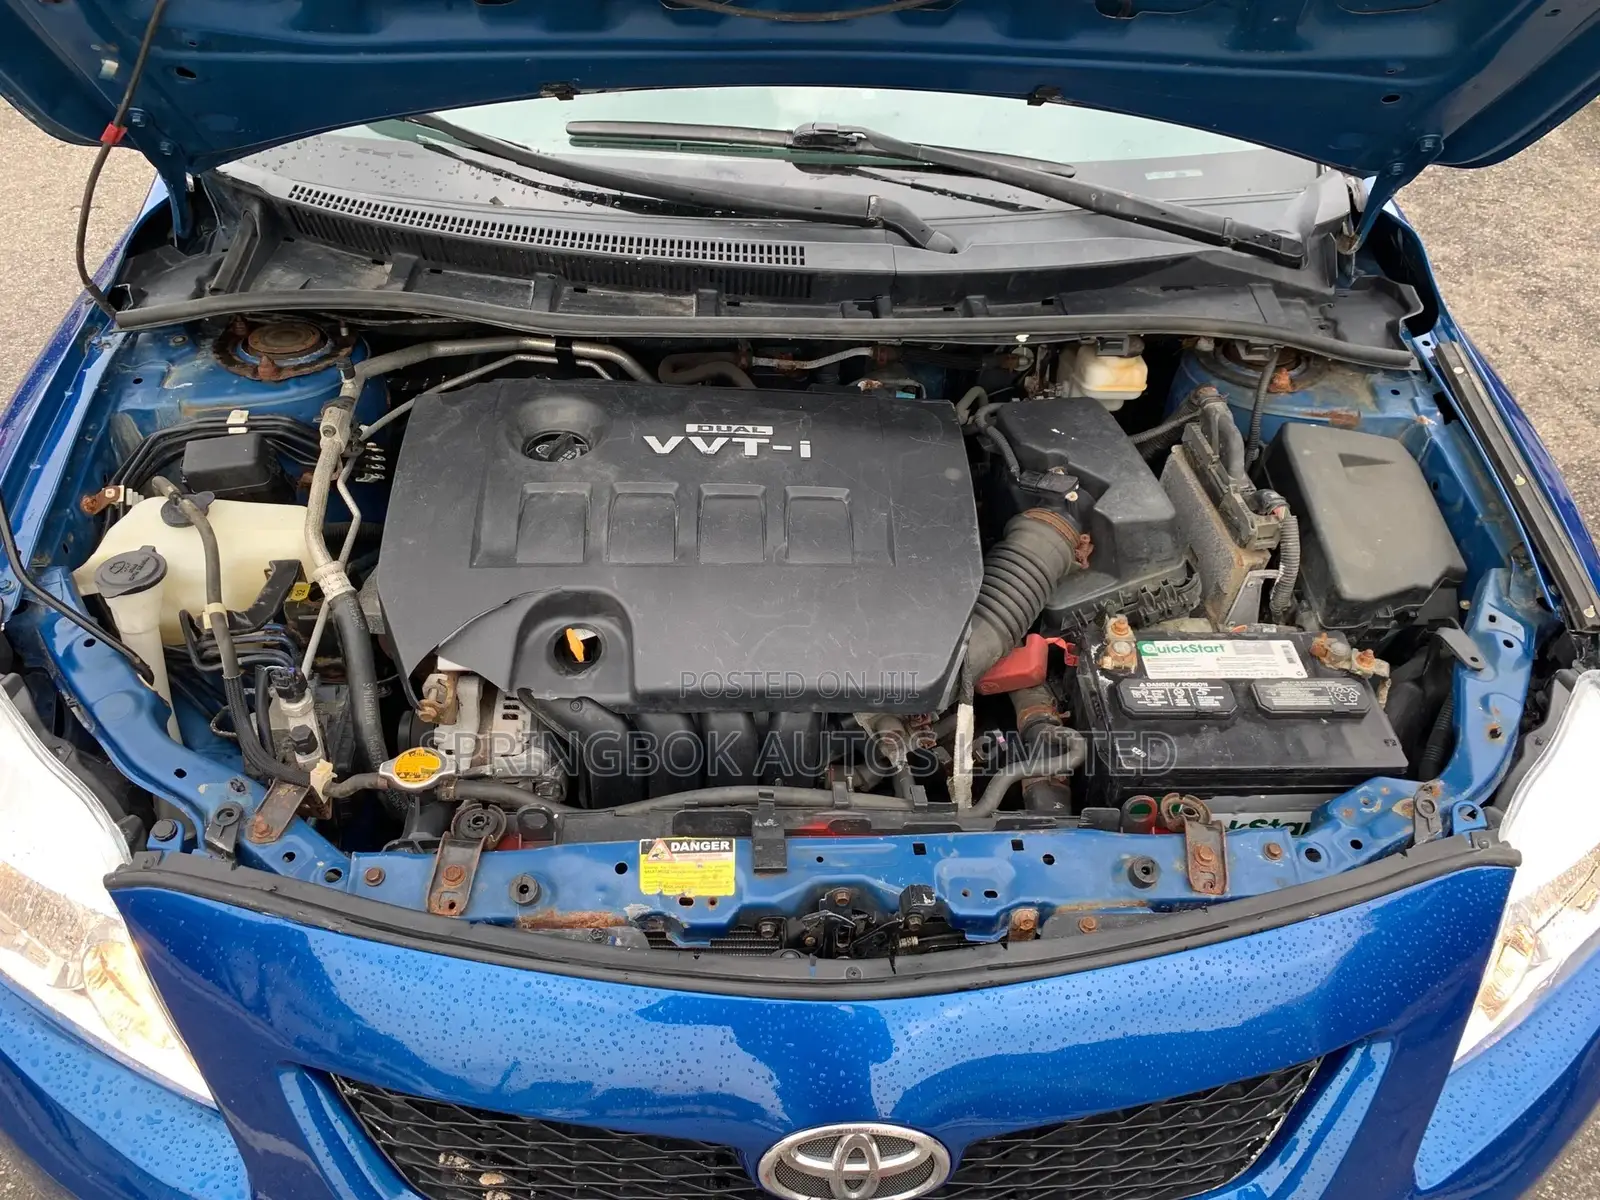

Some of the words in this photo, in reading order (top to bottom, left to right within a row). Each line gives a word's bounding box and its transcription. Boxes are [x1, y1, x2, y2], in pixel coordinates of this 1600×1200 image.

[697, 425, 767, 434] DUAL
[642, 435, 812, 458] VVT-i
[1141, 643, 1226, 655] QuickStart
[670, 840, 730, 852] DANGER
